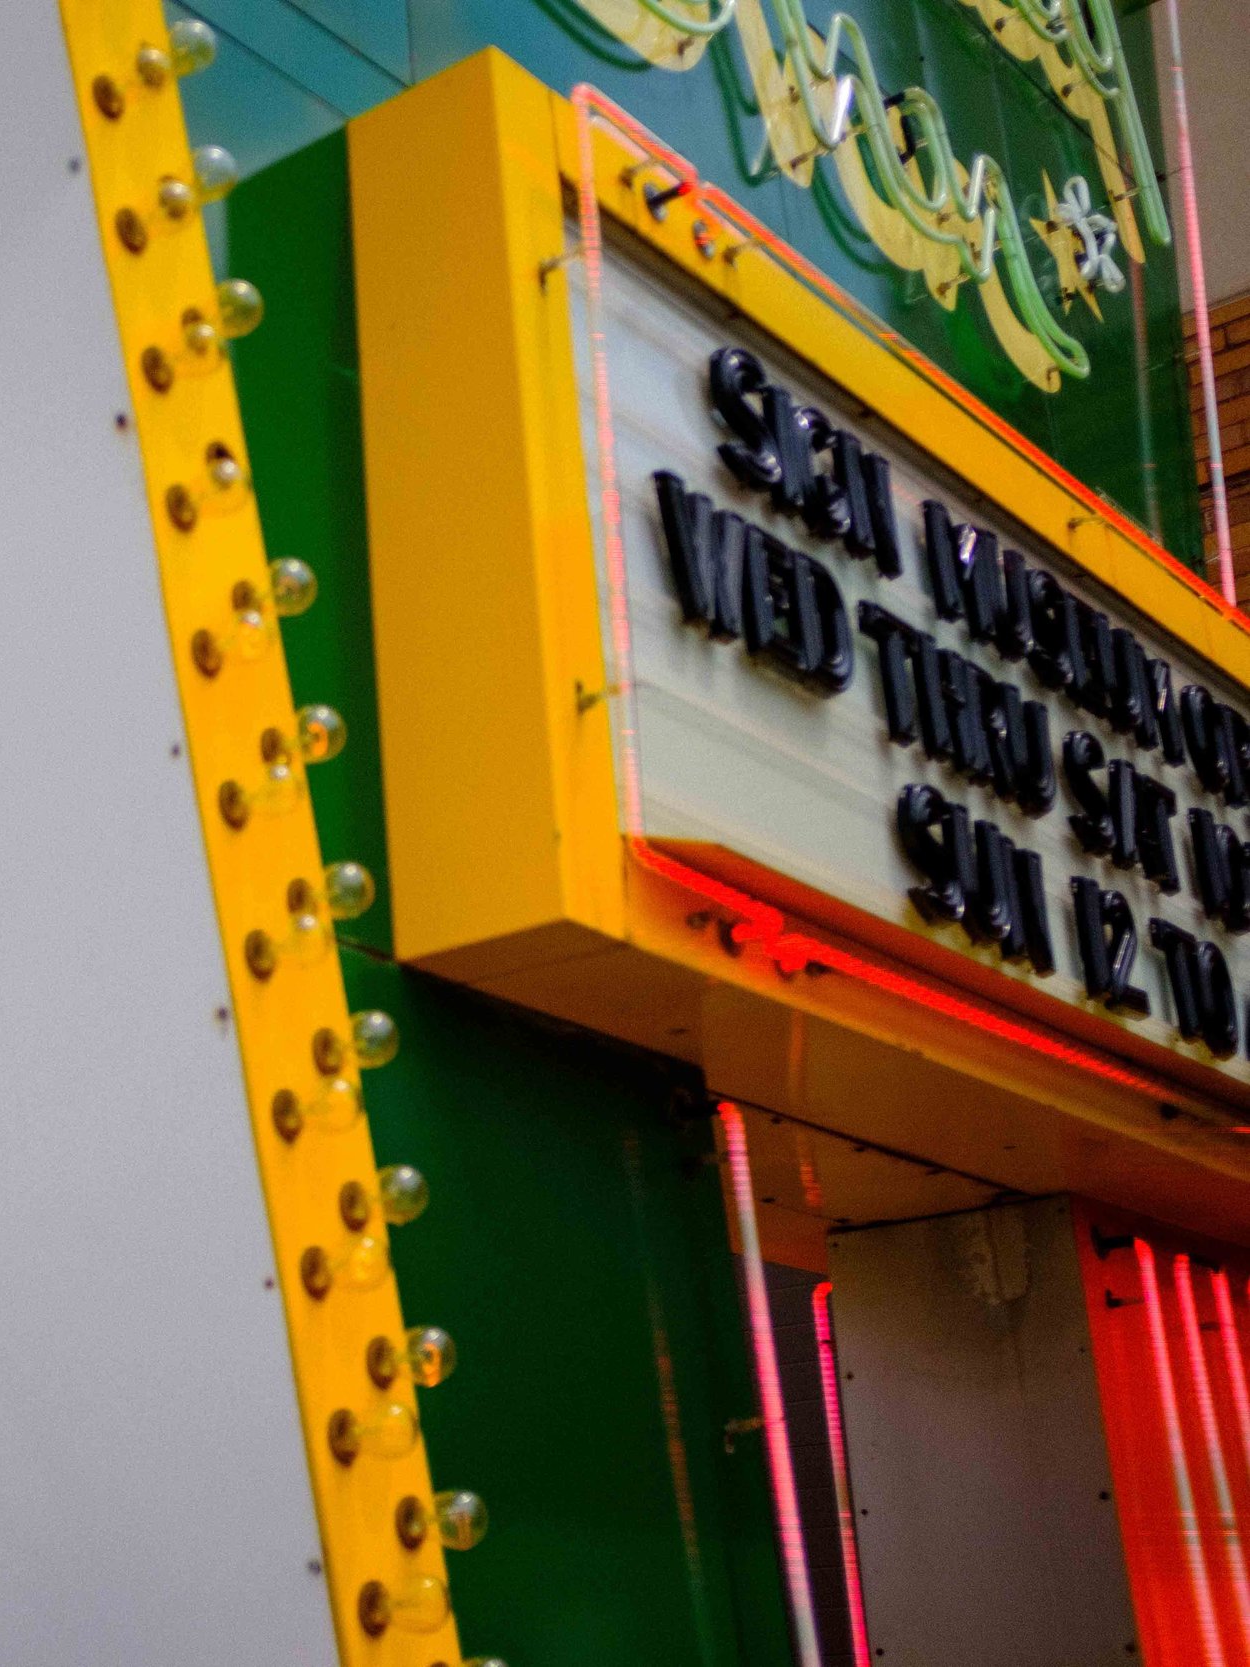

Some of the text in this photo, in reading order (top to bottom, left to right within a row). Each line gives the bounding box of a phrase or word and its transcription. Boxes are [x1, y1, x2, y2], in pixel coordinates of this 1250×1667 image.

[652, 469, 851, 694] WED
[859, 600, 1054, 819] THRU
[1069, 875, 1151, 1021] 12
[1149, 917, 1239, 1062] TO
